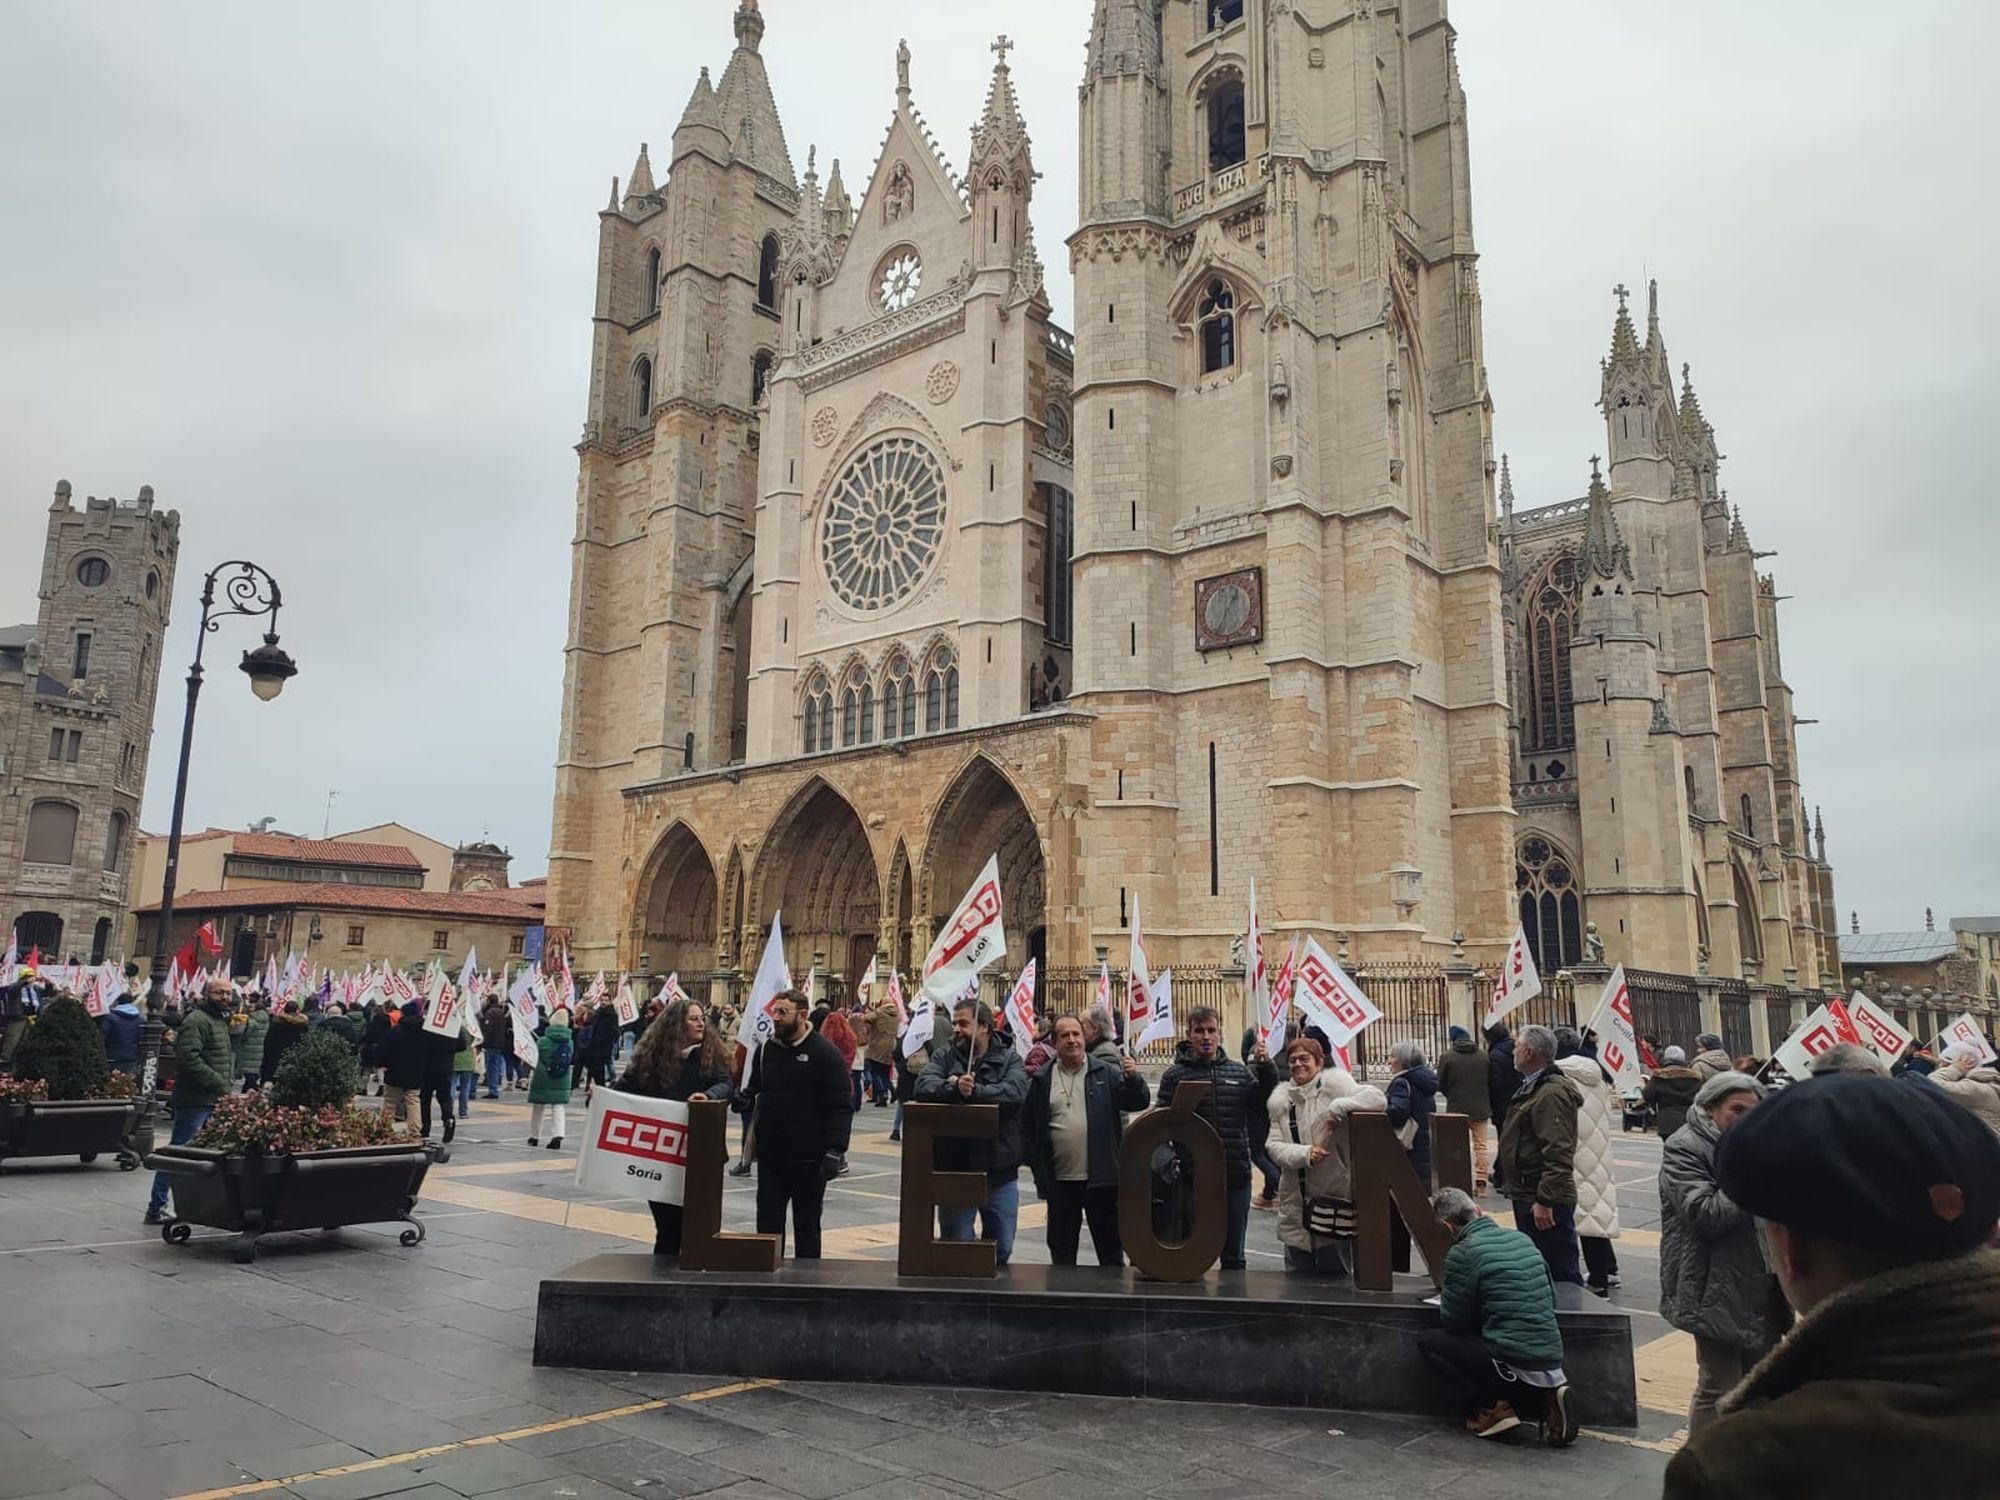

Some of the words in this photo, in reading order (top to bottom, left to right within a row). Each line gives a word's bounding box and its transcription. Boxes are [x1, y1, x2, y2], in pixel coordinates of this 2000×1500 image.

[1302, 960, 1362, 1024] CCOO
[606, 1117, 688, 1159] CCO
[627, 1164, 662, 1182] Soria
[679, 1081, 1469, 1292] LEÓN
